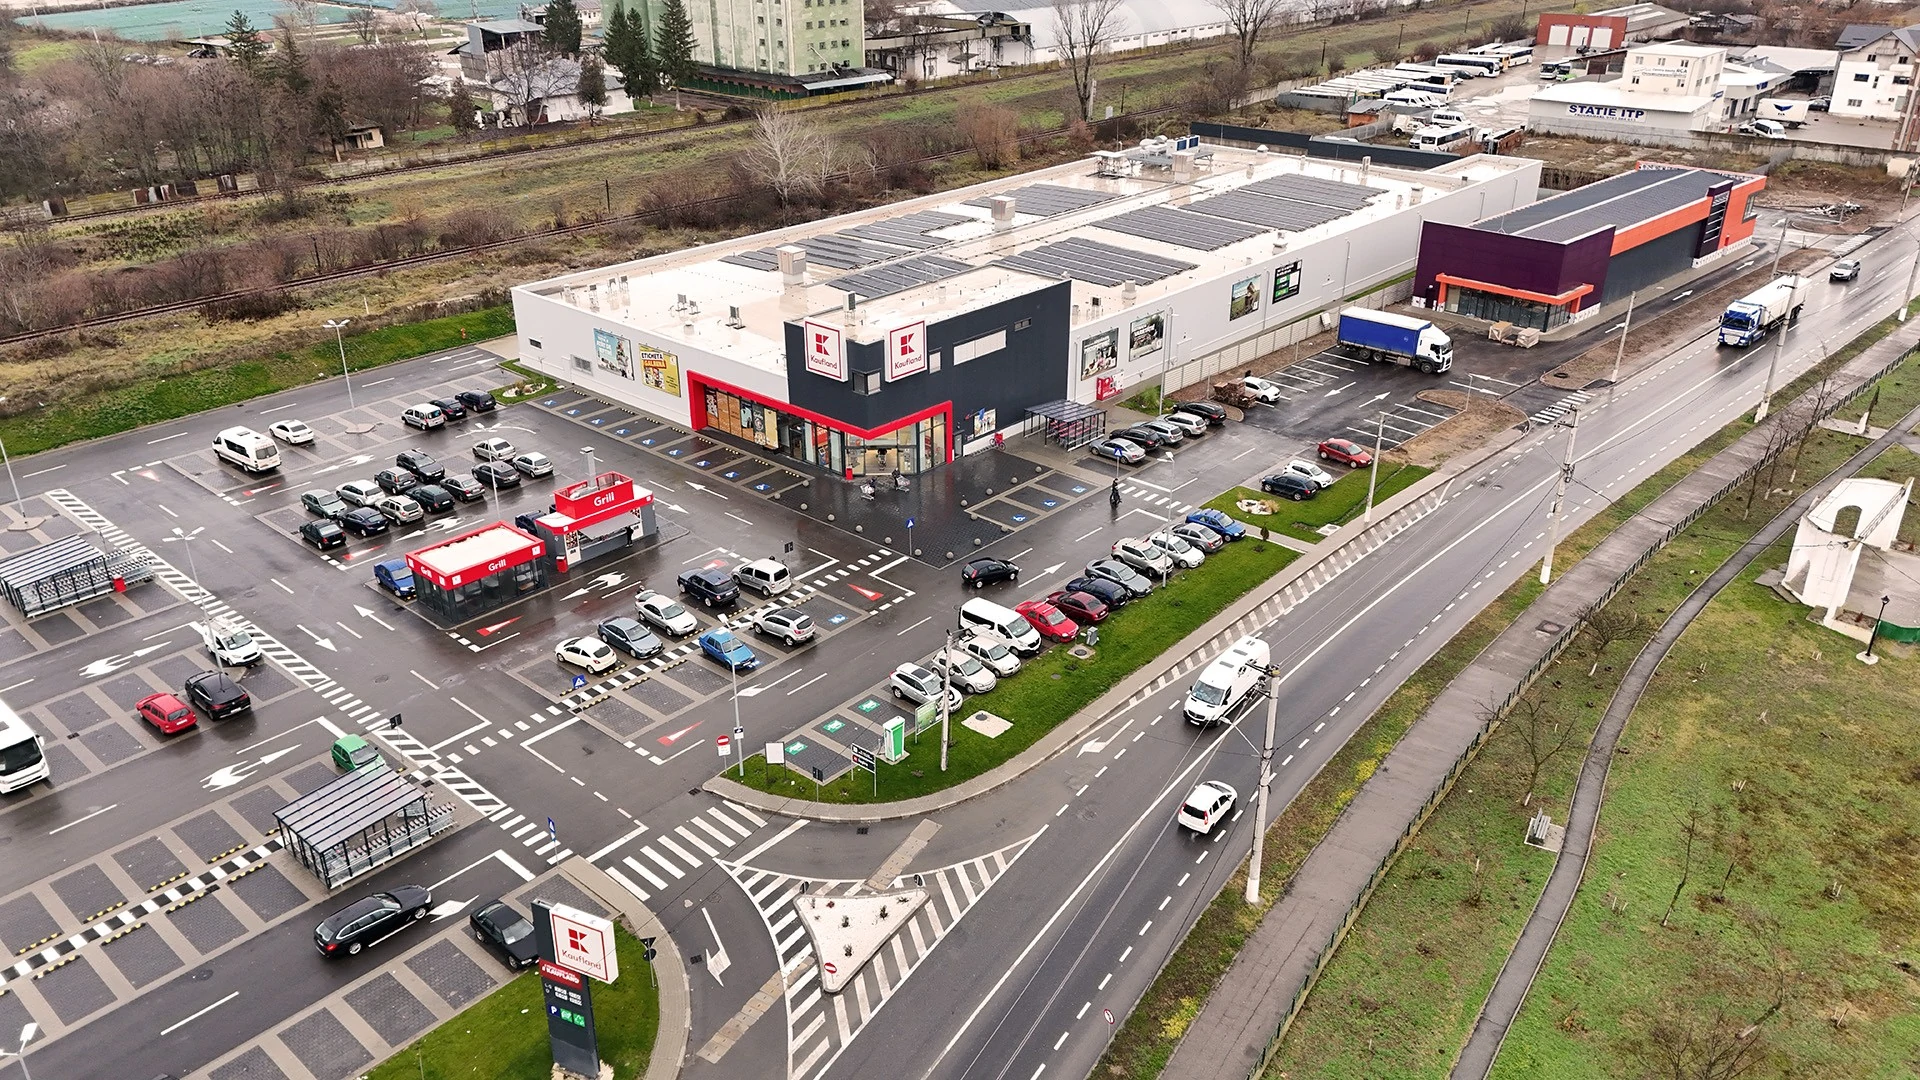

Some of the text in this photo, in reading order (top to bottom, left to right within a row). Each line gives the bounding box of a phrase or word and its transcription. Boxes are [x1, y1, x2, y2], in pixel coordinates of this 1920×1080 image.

[1569, 104, 1617, 117] STATIE
[1621, 109, 1645, 119] ITP
[810, 354, 838, 369] Kaufland
[894, 355, 922, 369] Kaufland
[594, 491, 615, 506] Grill
[420, 566, 433, 578] Grill
[488, 559, 507, 572] Grill
[561, 949, 602, 971] Kaufland
